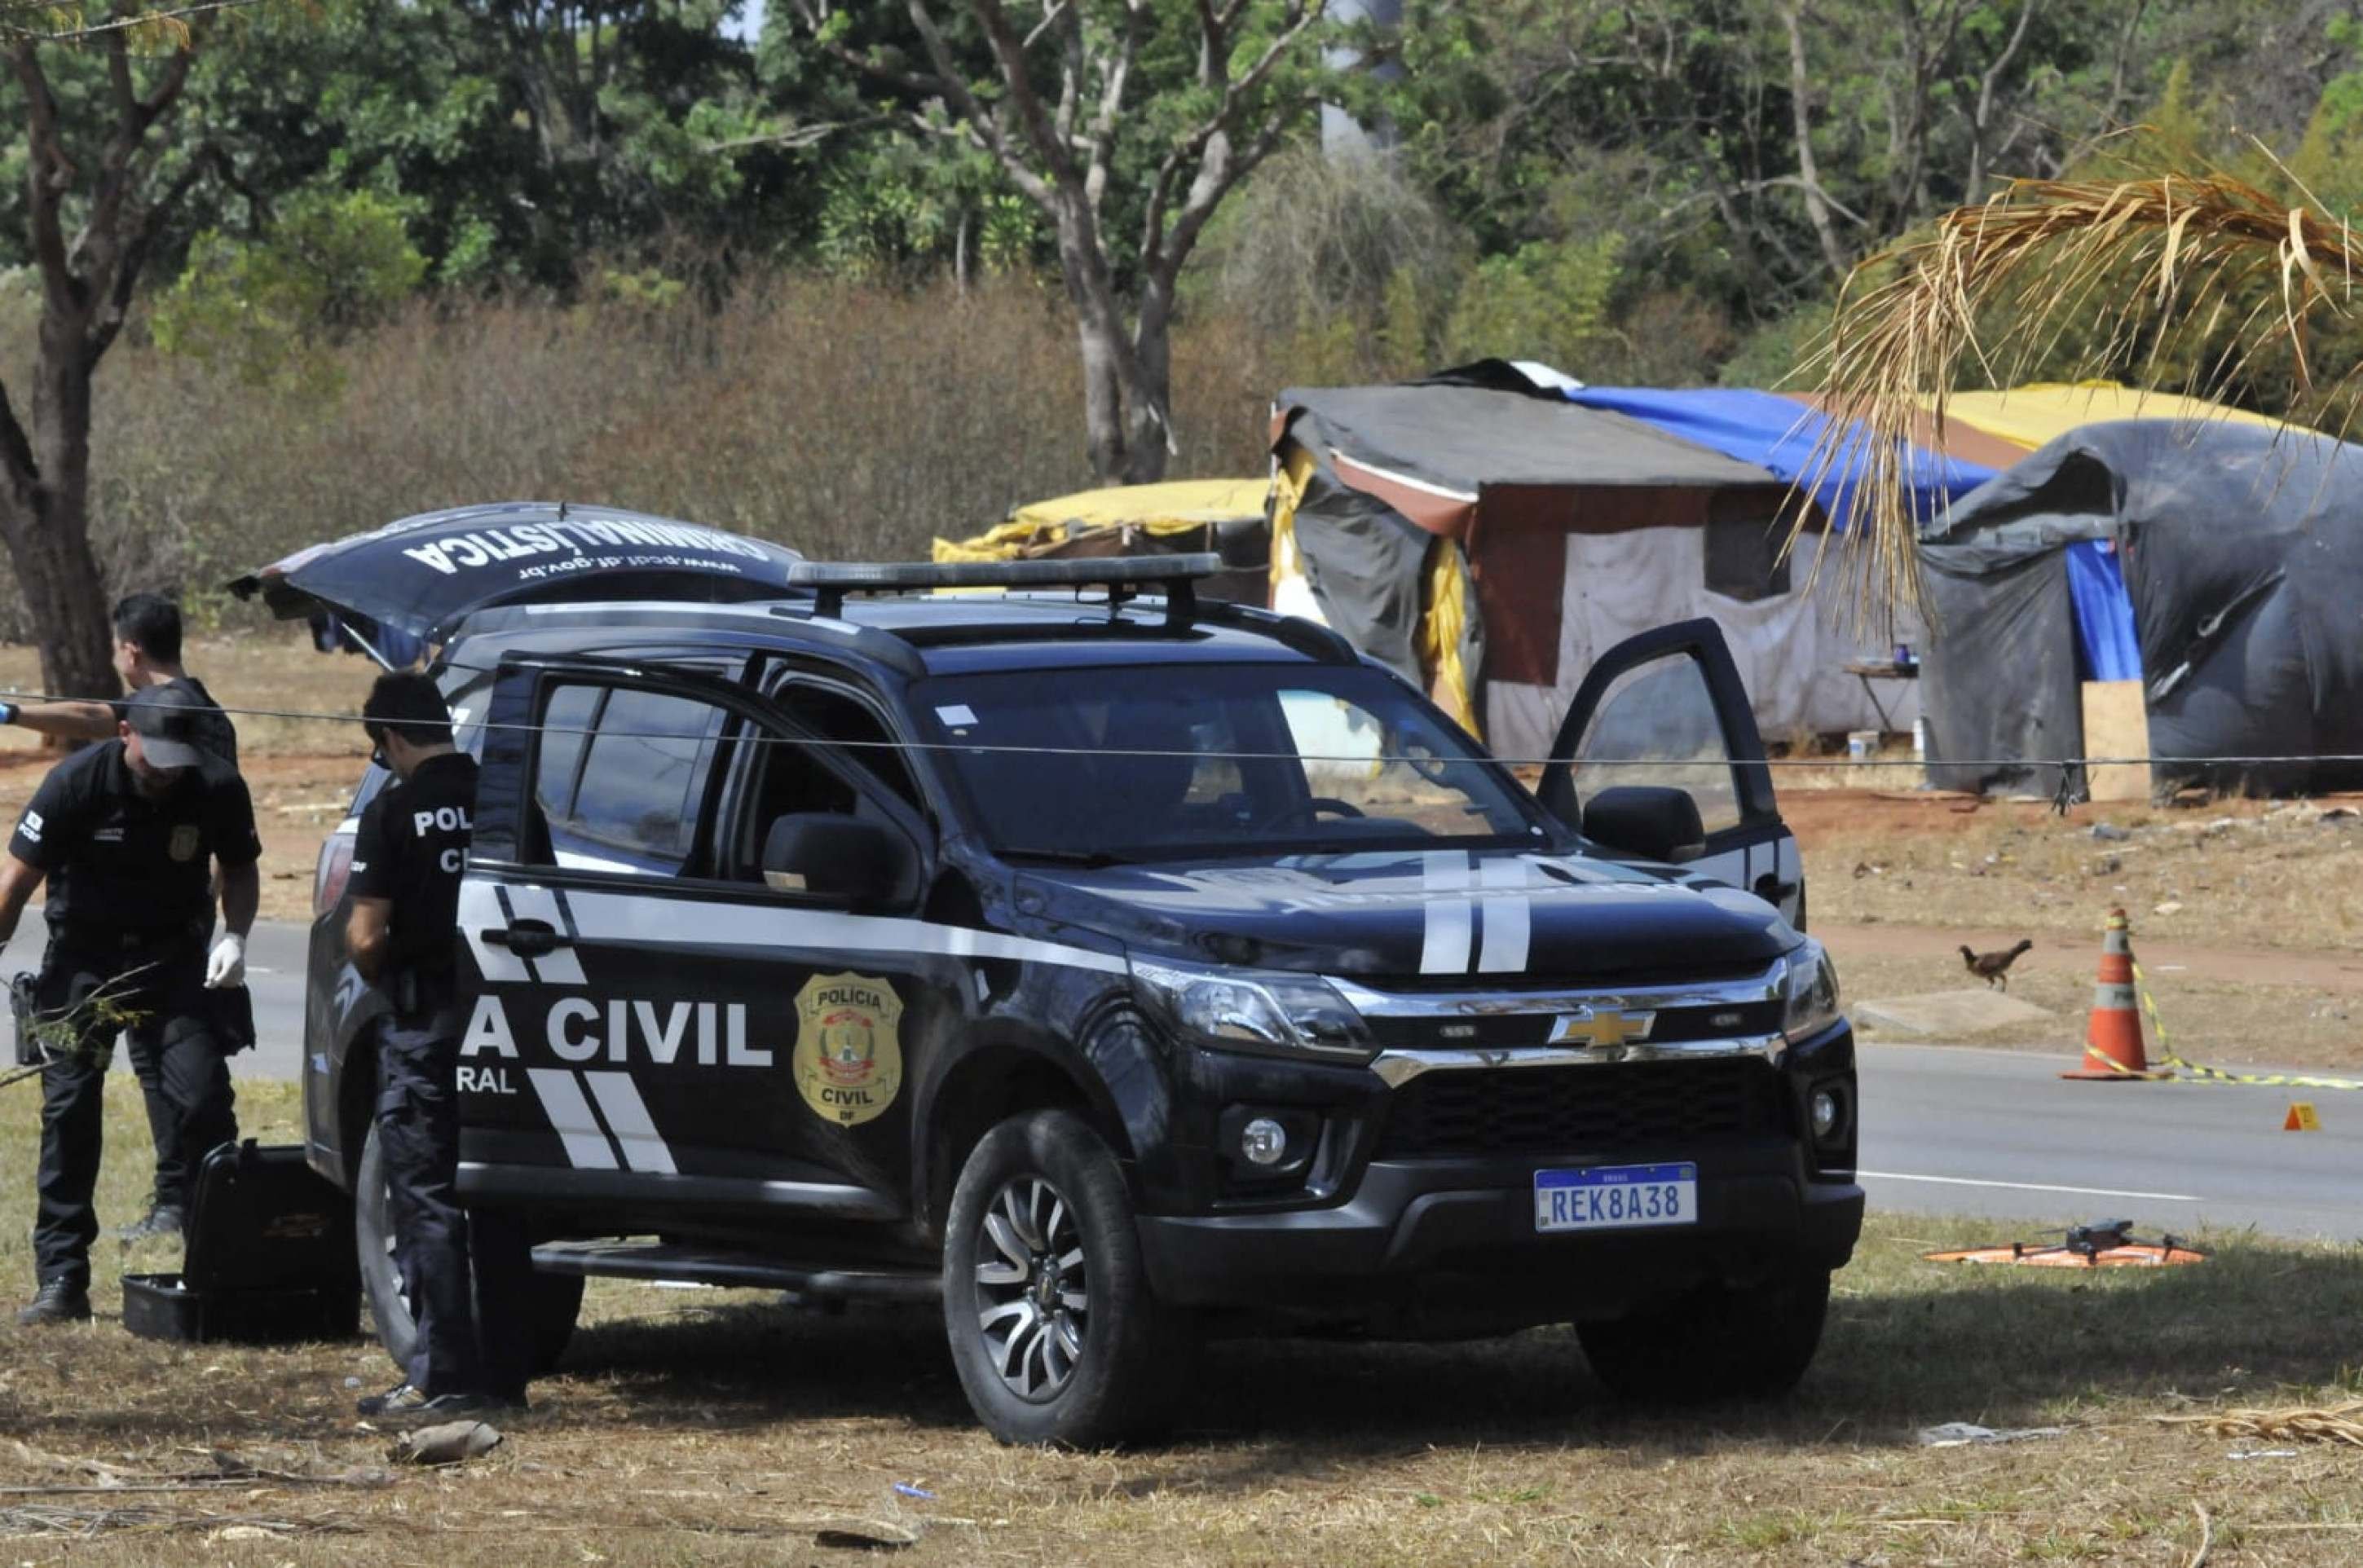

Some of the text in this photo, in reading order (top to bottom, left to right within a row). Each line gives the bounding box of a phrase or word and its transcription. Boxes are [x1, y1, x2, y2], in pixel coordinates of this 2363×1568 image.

[403, 519, 769, 575] CRIMINALÍSTICA
[818, 986, 881, 1006] POLÍCIA
[546, 998, 774, 1067] CIVIL
[822, 1087, 874, 1105] CIVIL
[1553, 1185, 1680, 1223] REK8A38
